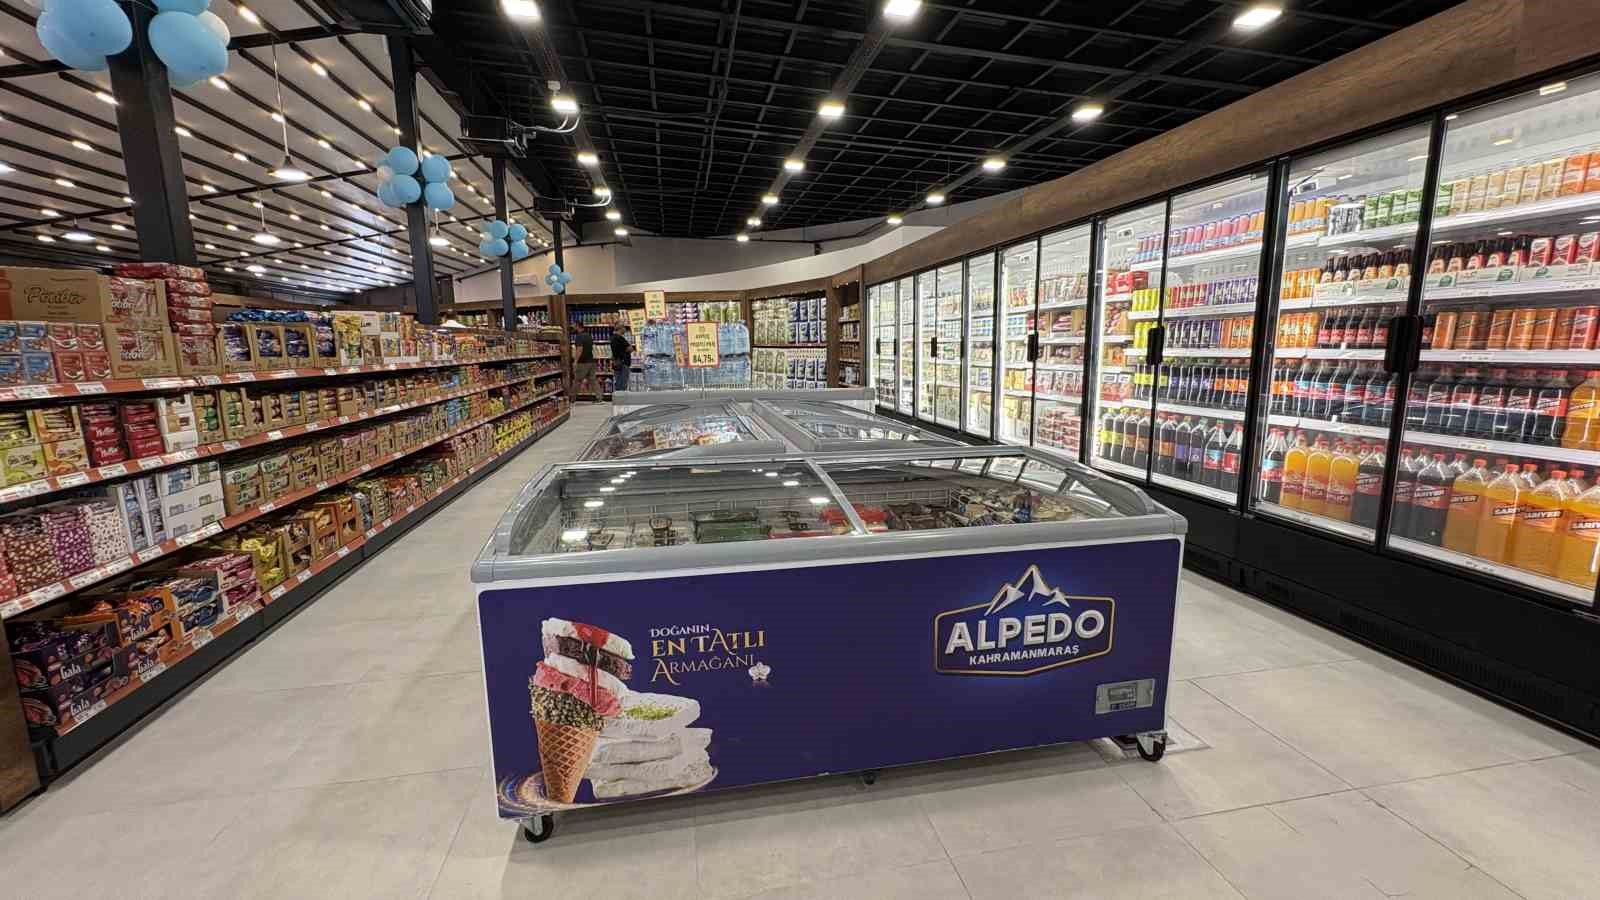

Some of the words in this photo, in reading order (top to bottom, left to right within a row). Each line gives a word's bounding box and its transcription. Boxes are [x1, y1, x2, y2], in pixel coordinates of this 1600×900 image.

[650, 623, 710, 638] DOĞANIN
[651, 638, 686, 657] EN
[690, 627, 765, 656] TATLI
[944, 609, 1105, 655] ALPEDO
[651, 653, 754, 686] ARMAĞANI
[969, 644, 1080, 666] KAHRAMANMARAŞ
